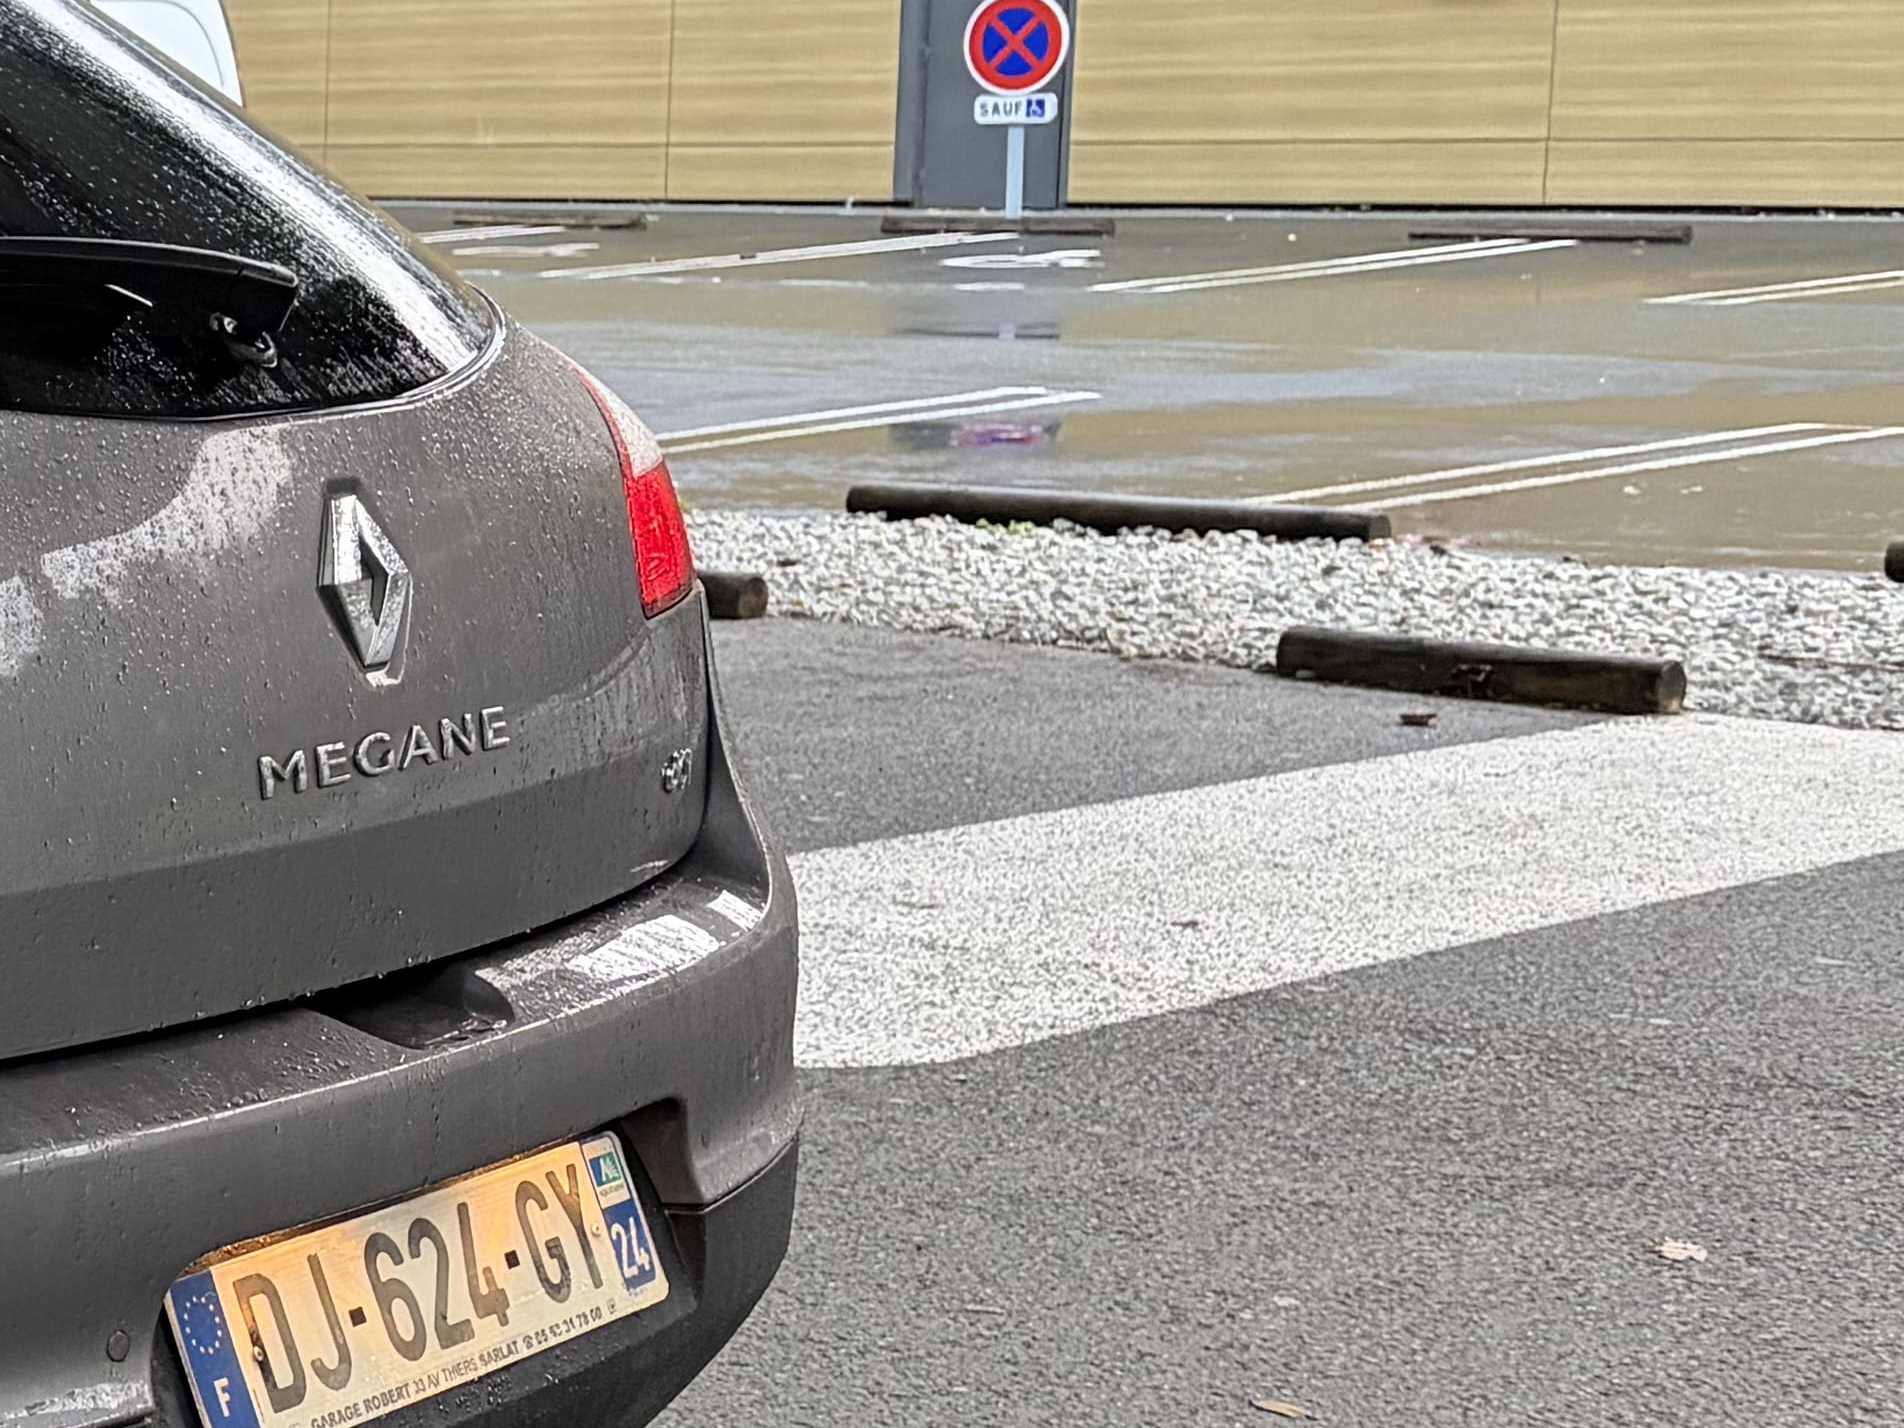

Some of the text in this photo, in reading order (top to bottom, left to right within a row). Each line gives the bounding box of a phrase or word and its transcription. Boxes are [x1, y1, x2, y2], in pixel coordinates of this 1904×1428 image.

[979, 100, 1023, 117] SAUF
[257, 706, 511, 800] MEGANE
[611, 1217, 650, 1278] 24
[232, 1164, 604, 1413] DJ-624-GY
[214, 1377, 231, 1417] F
[363, 1381, 411, 1413] ROBERT
[427, 1372, 440, 1388] AV
[442, 1357, 478, 1382] THIERS
[478, 1340, 520, 1367] SARLAT
